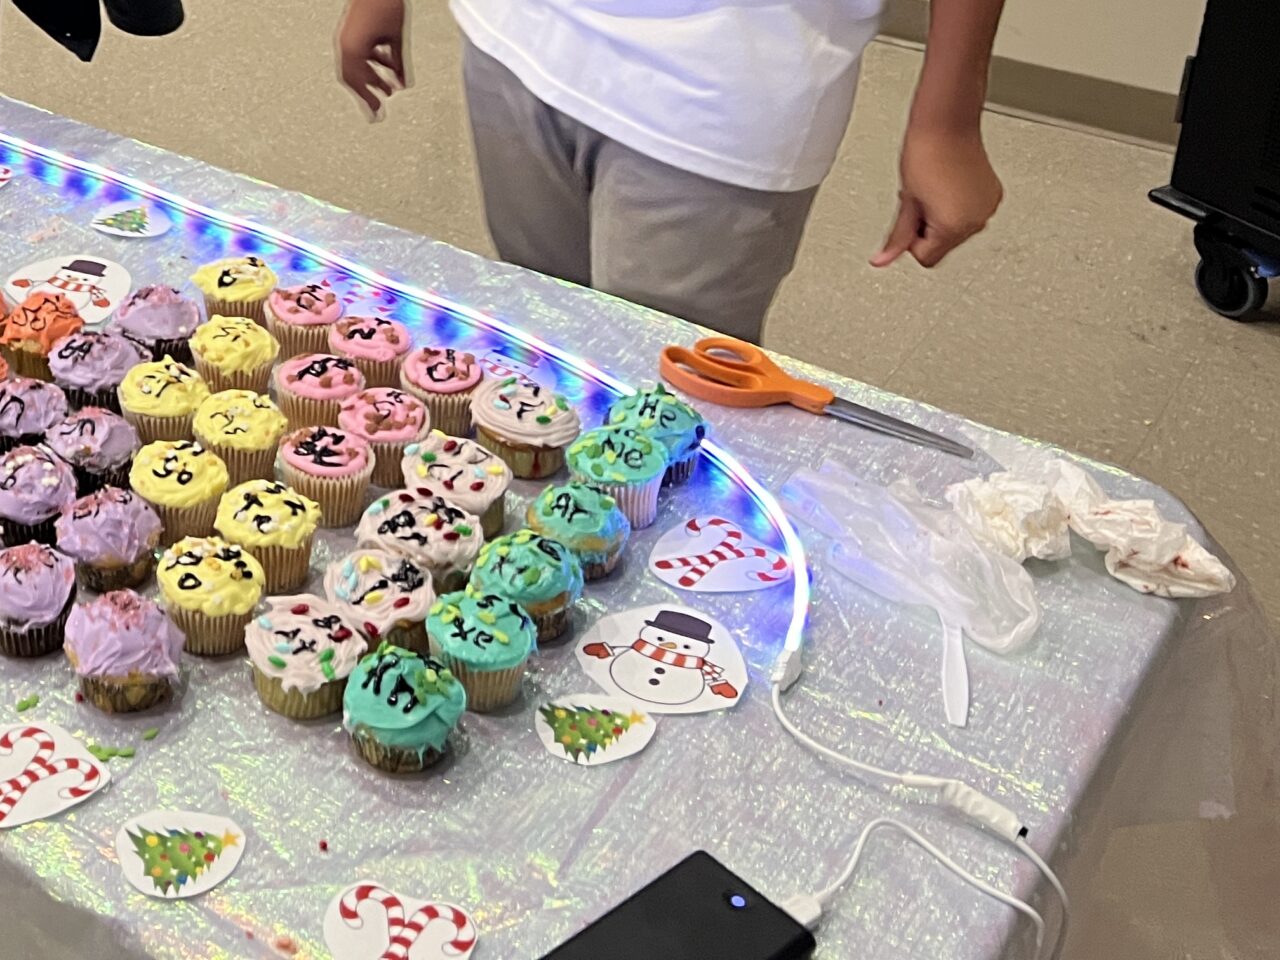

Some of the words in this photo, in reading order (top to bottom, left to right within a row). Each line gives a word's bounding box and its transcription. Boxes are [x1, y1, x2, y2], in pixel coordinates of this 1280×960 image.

[516, 400, 545, 420] F
[638, 397, 677, 429] He
[600, 436, 644, 470] Ne
[551, 492, 592, 524] Ar
[450, 616, 495, 650] Xe
